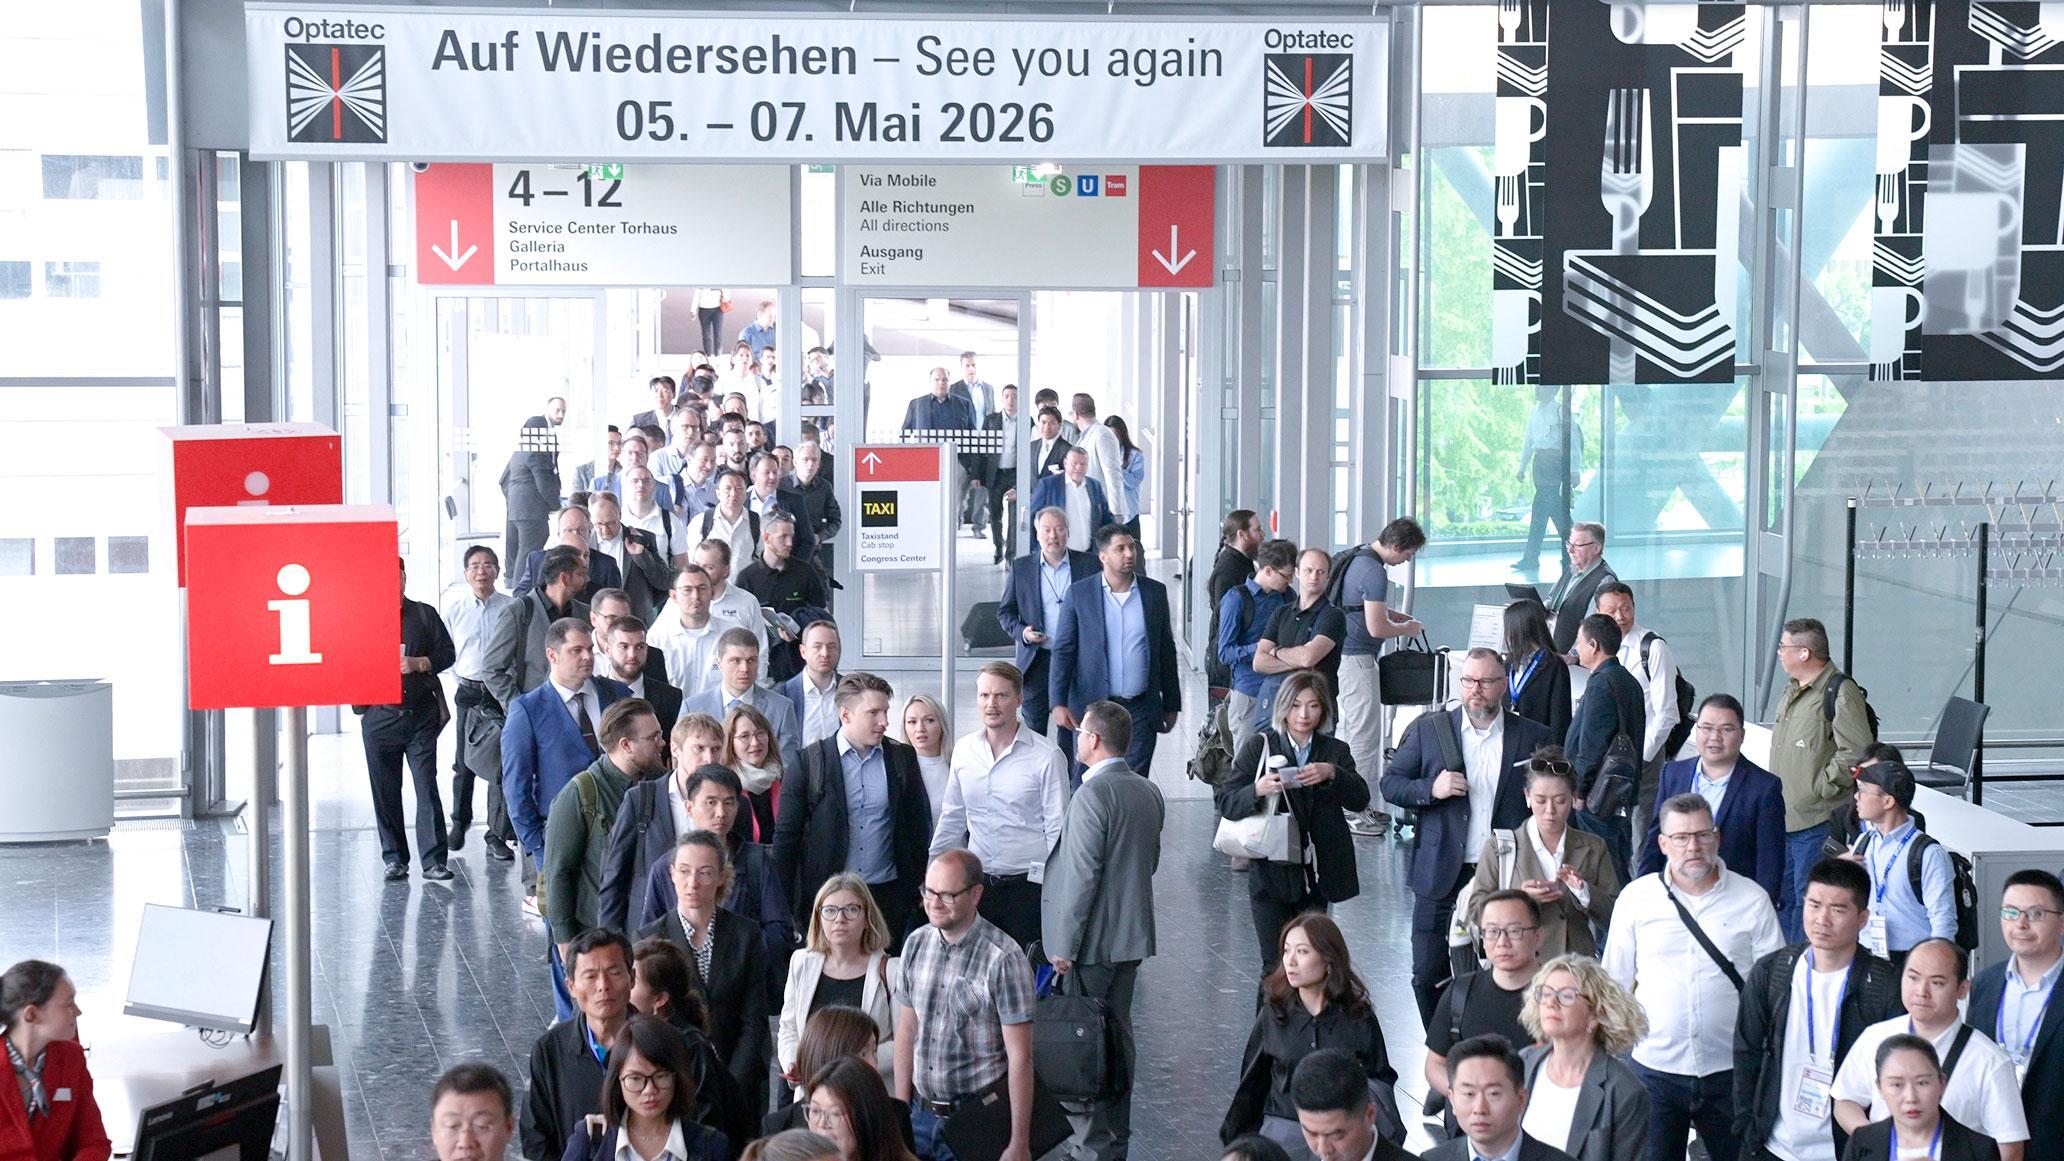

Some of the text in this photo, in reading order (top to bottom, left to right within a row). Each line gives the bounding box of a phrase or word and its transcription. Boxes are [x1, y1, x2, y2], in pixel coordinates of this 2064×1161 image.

[283, 17, 385, 42] Optatec
[1264, 29, 1354, 52] Optatec
[431, 29, 519, 72] Auf
[535, 31, 857, 75] Wiedersehen
[916, 35, 996, 77] See
[1011, 47, 1089, 87] you
[1107, 37, 1222, 88] again
[616, 99, 688, 142] 05.
[750, 100, 813, 142] 07.
[835, 101, 921, 143] Mai
[939, 102, 1055, 143] 2026
[860, 174, 937, 187] Via Mobile
[1056, 178, 1067, 193] S
[1082, 178, 1094, 193] U
[1106, 181, 1125, 189] Tram
[860, 201, 975, 217] Alle Richtungen
[509, 221, 678, 235] Service Center Torhaus
[860, 218, 950, 232] All directions
[509, 239, 565, 253] Galleria
[860, 245, 923, 261] Ausgang
[510, 258, 588, 272] Portalhaus
[860, 262, 886, 275] Exit
[863, 502, 895, 515] TAXI
[861, 532, 899, 540] Taxistand
[861, 541, 895, 550] Cab stop
[861, 554, 927, 564] Congress Center
